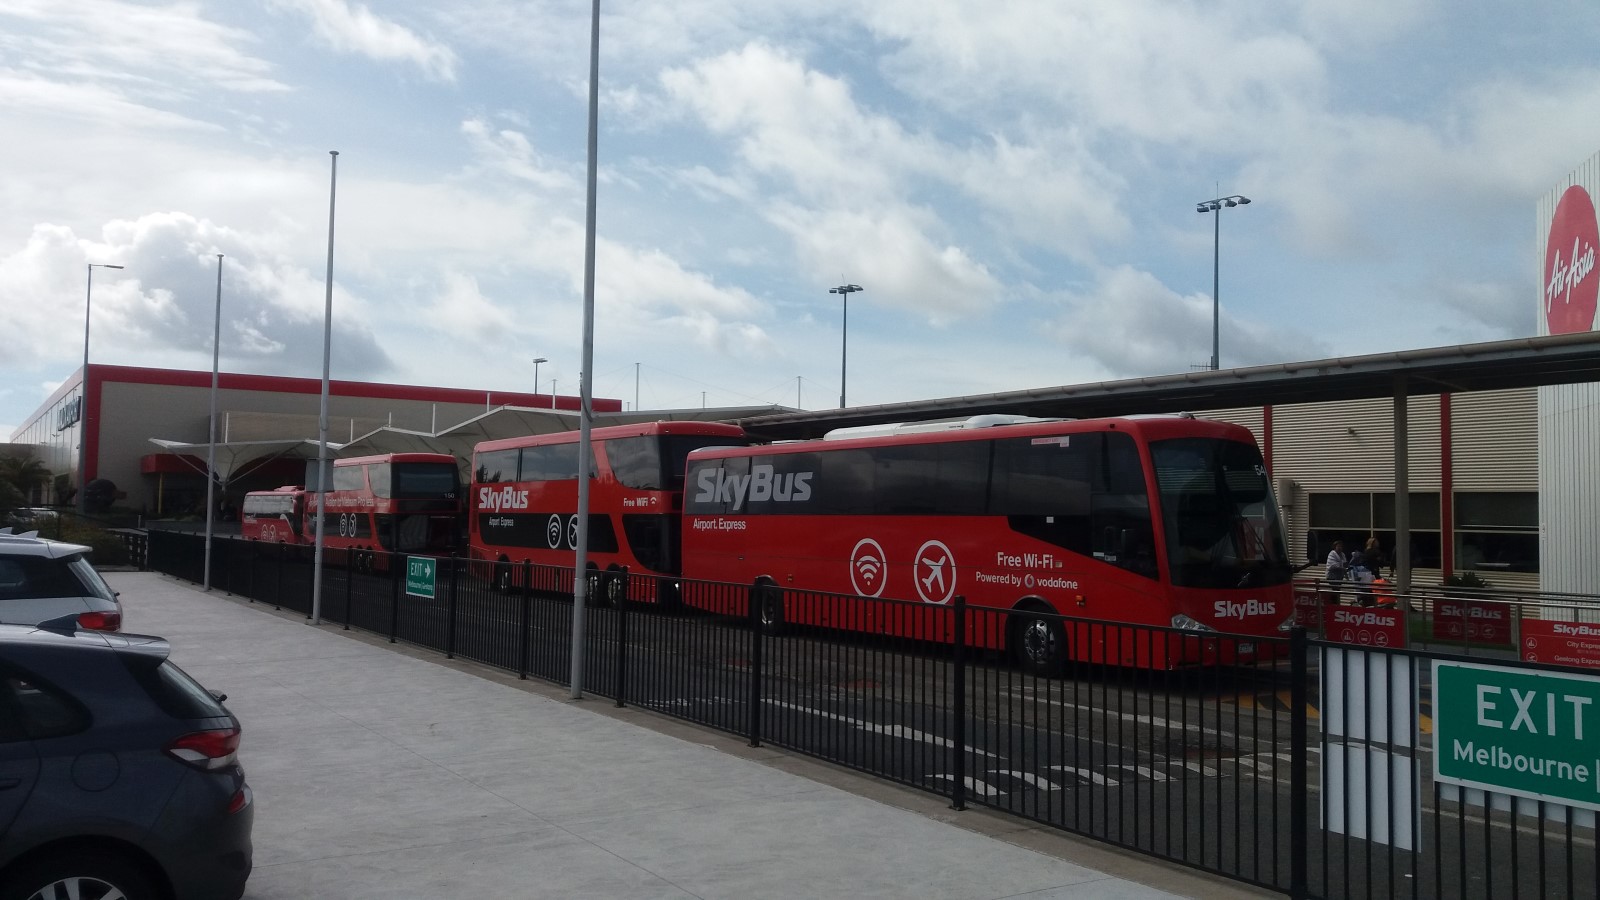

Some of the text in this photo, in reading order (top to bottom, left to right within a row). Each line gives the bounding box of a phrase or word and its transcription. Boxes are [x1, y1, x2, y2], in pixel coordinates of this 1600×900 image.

[695, 464, 813, 510] SkyBus
[478, 486, 528, 513] SkyBus
[623, 497, 635, 507] Free
[488, 516, 514, 528] Airport Express
[693, 518, 746, 532] Airport Express
[410, 562, 423, 576] EXIT
[997, 551, 1053, 570] Free Wi-Fi
[976, 571, 1079, 590] Powered by vodafone
[1214, 599, 1276, 620] SkyBus
[1334, 609, 1397, 627] SkyBus
[1566, 641, 1580, 649] City
[1476, 684, 1593, 740] EXIT
[1453, 738, 1589, 783] Melbourne
